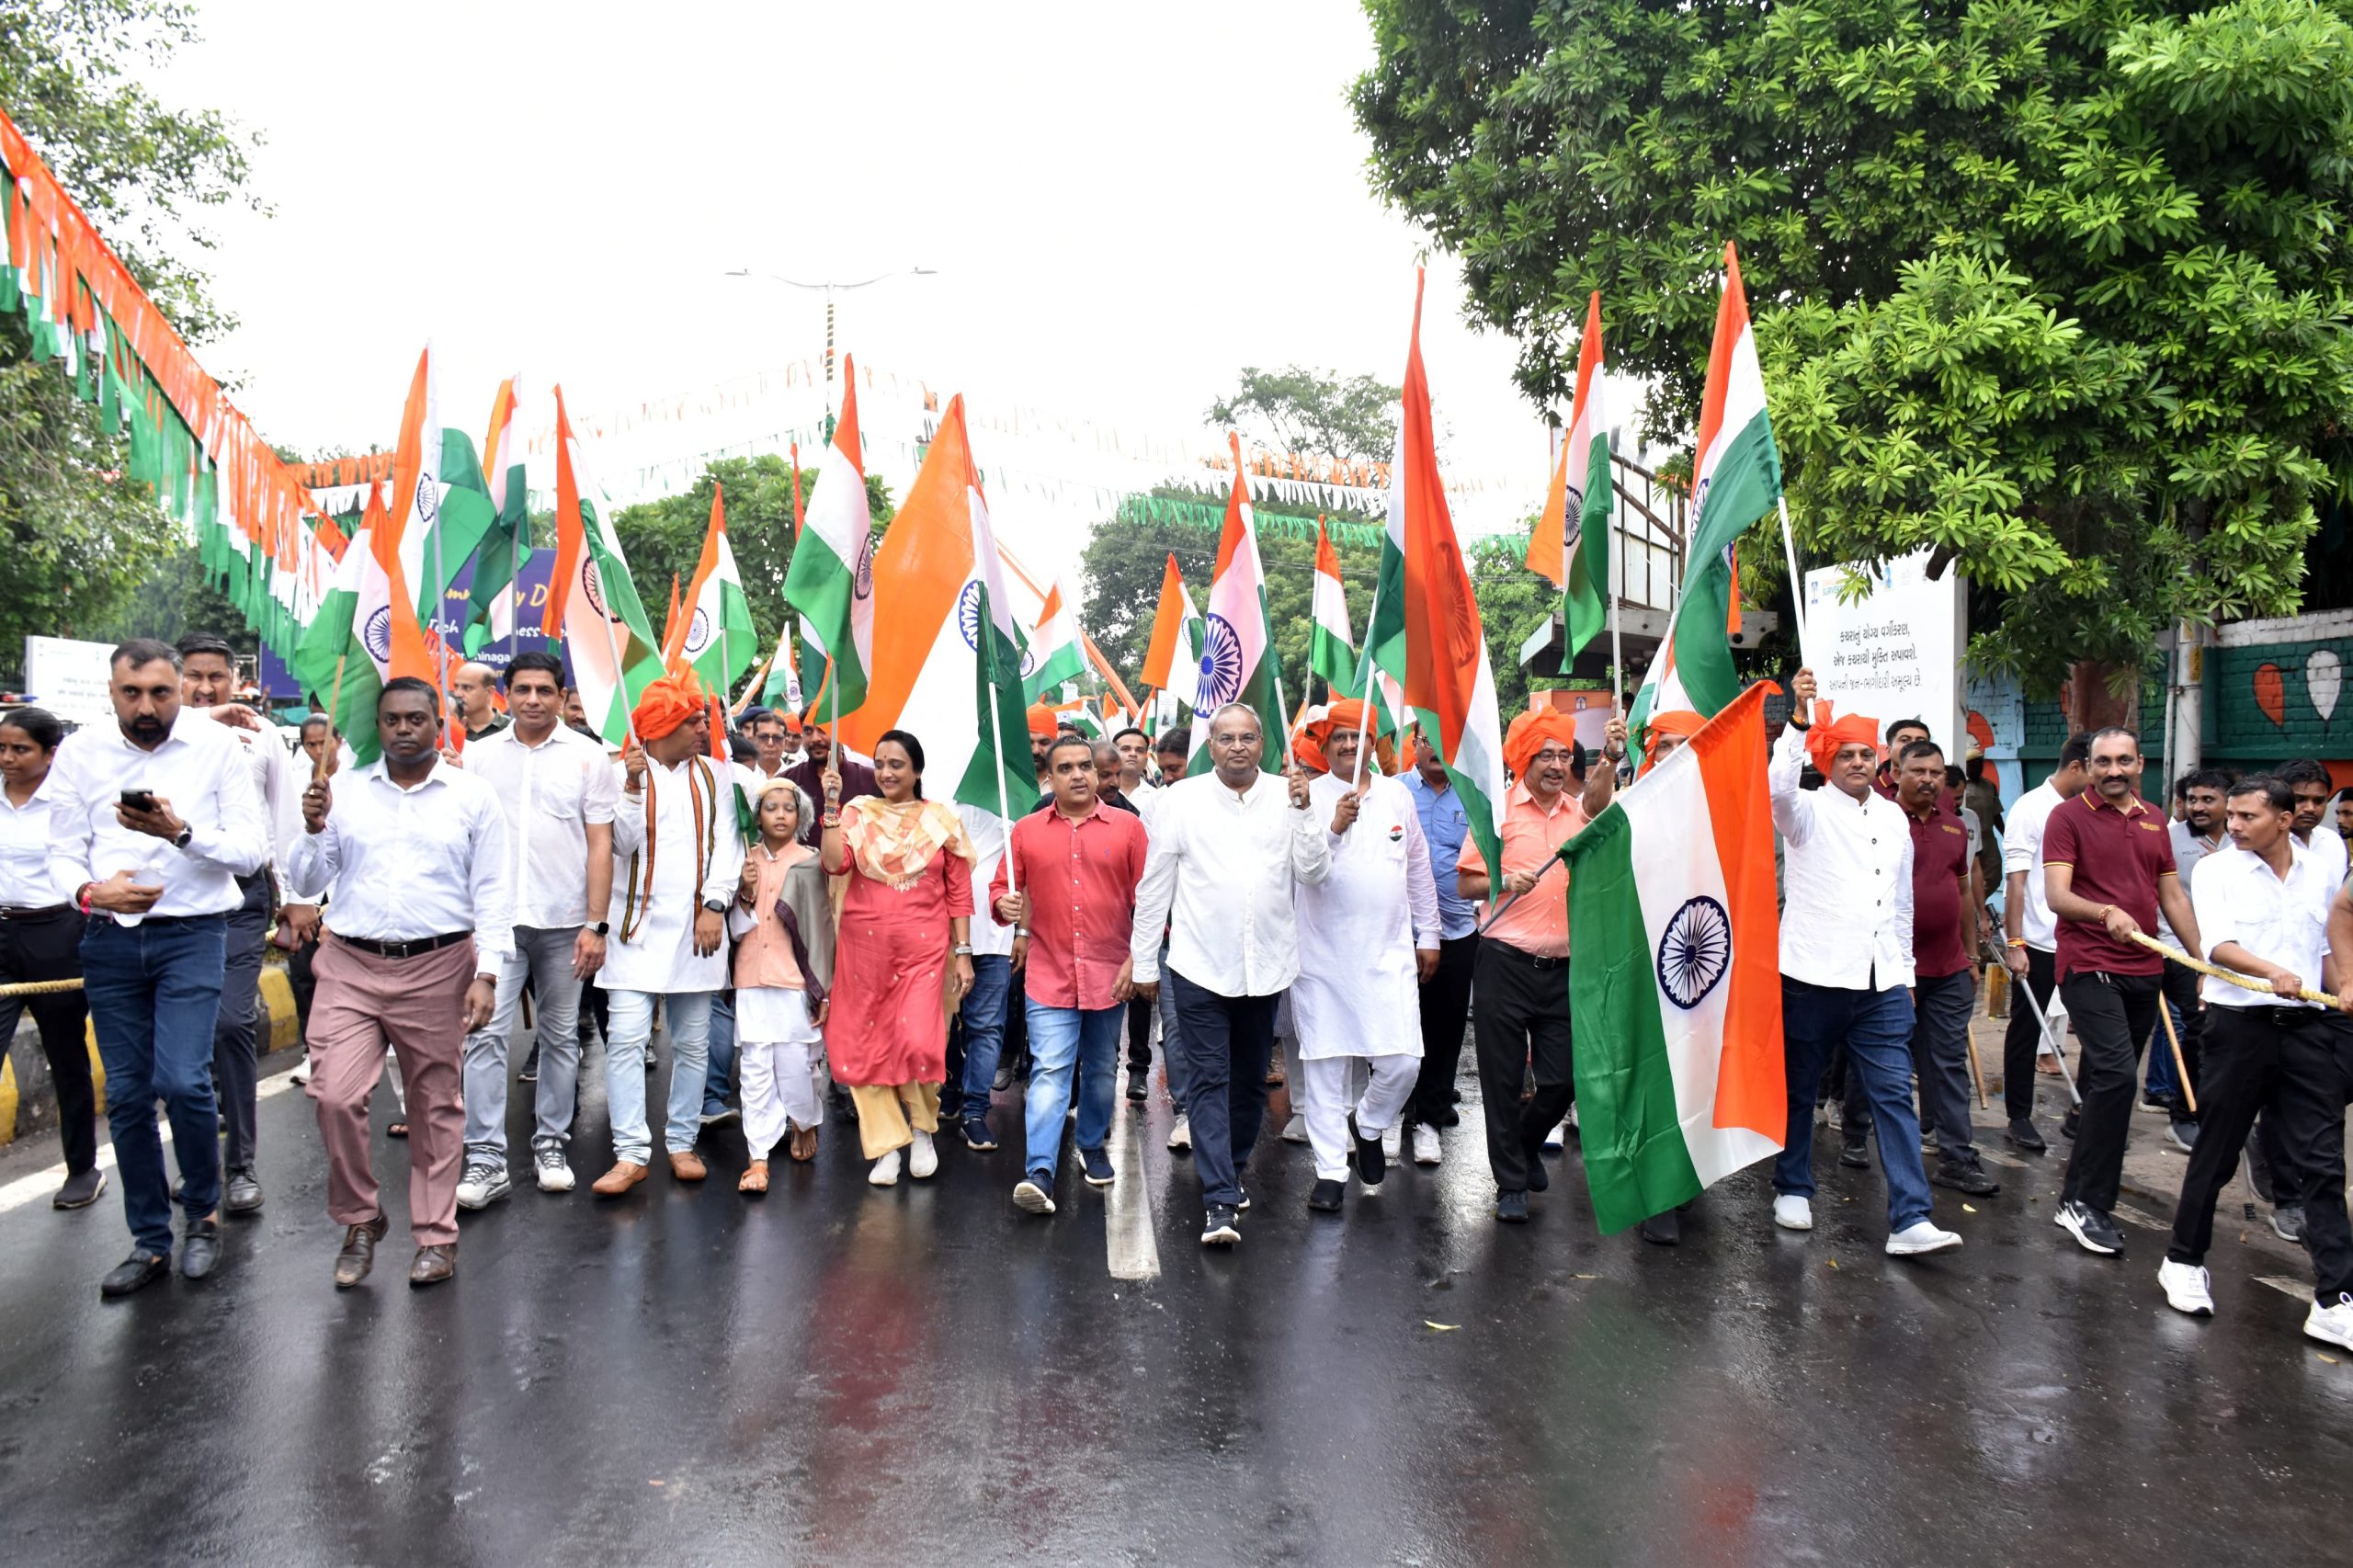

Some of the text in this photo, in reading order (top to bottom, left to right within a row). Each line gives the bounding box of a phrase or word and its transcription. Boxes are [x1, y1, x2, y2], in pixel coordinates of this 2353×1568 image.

[1840, 625, 1860, 645] કચરાનું
[1863, 623, 1879, 640] યોગ્ય
[1847, 648, 1870, 665] કચરાથી
[1871, 647, 1889, 668] મુક્તિ
